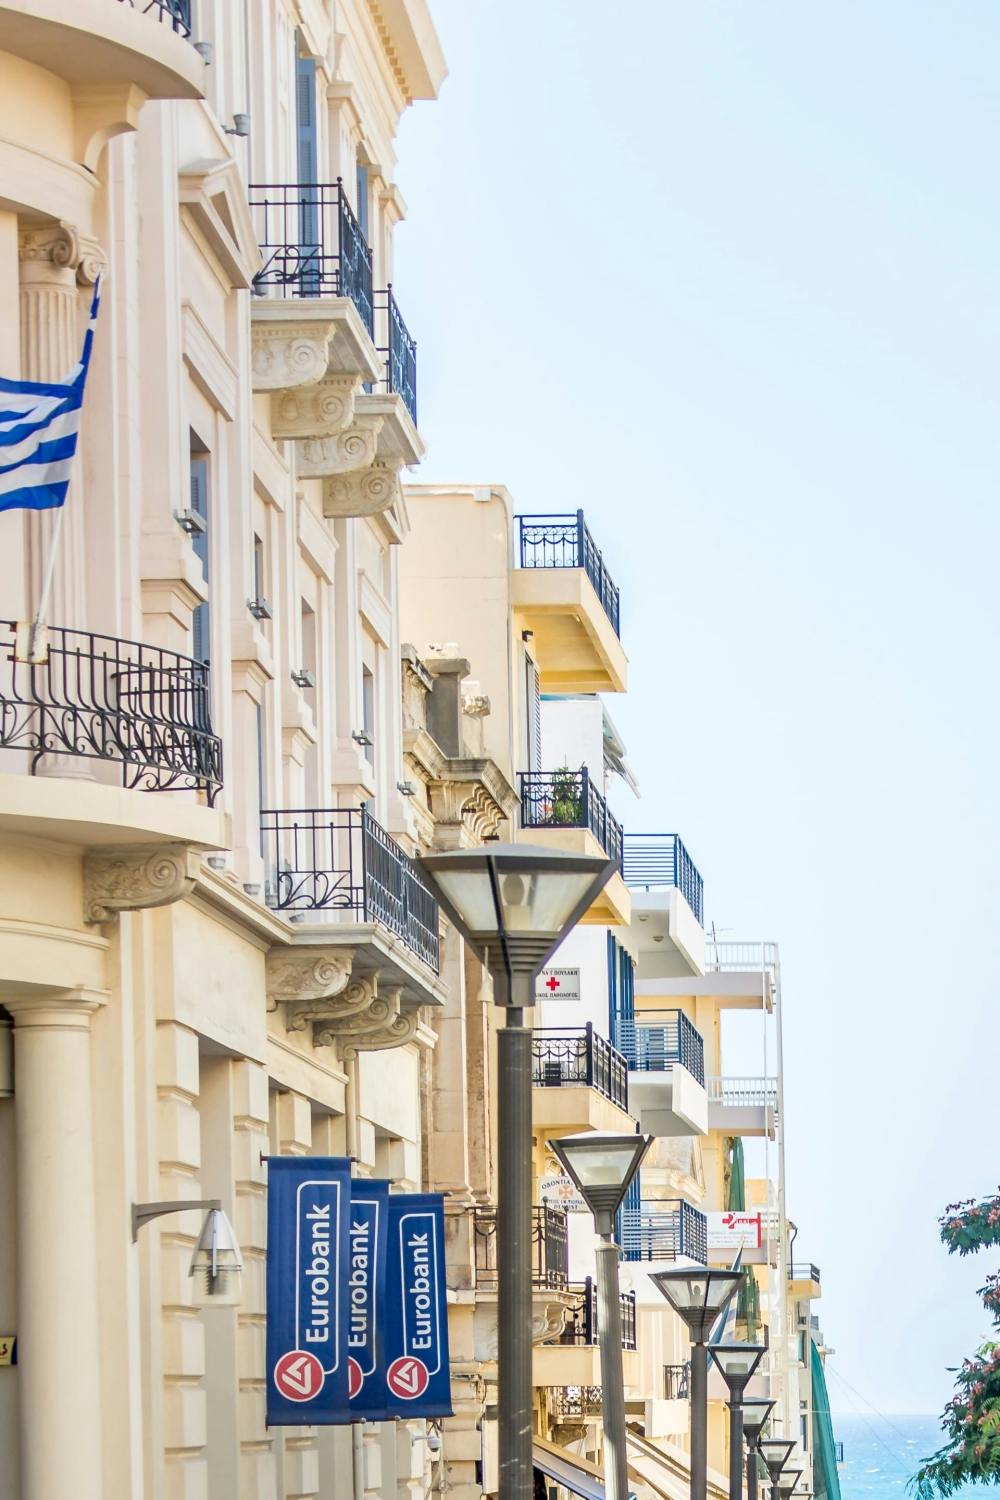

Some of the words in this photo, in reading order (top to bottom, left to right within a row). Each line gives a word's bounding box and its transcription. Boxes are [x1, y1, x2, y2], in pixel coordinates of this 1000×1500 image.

[306, 1204, 331, 1343] Eurobank
[348, 1221, 370, 1348] Eurobank
[408, 1232, 432, 1350] Eurobank
